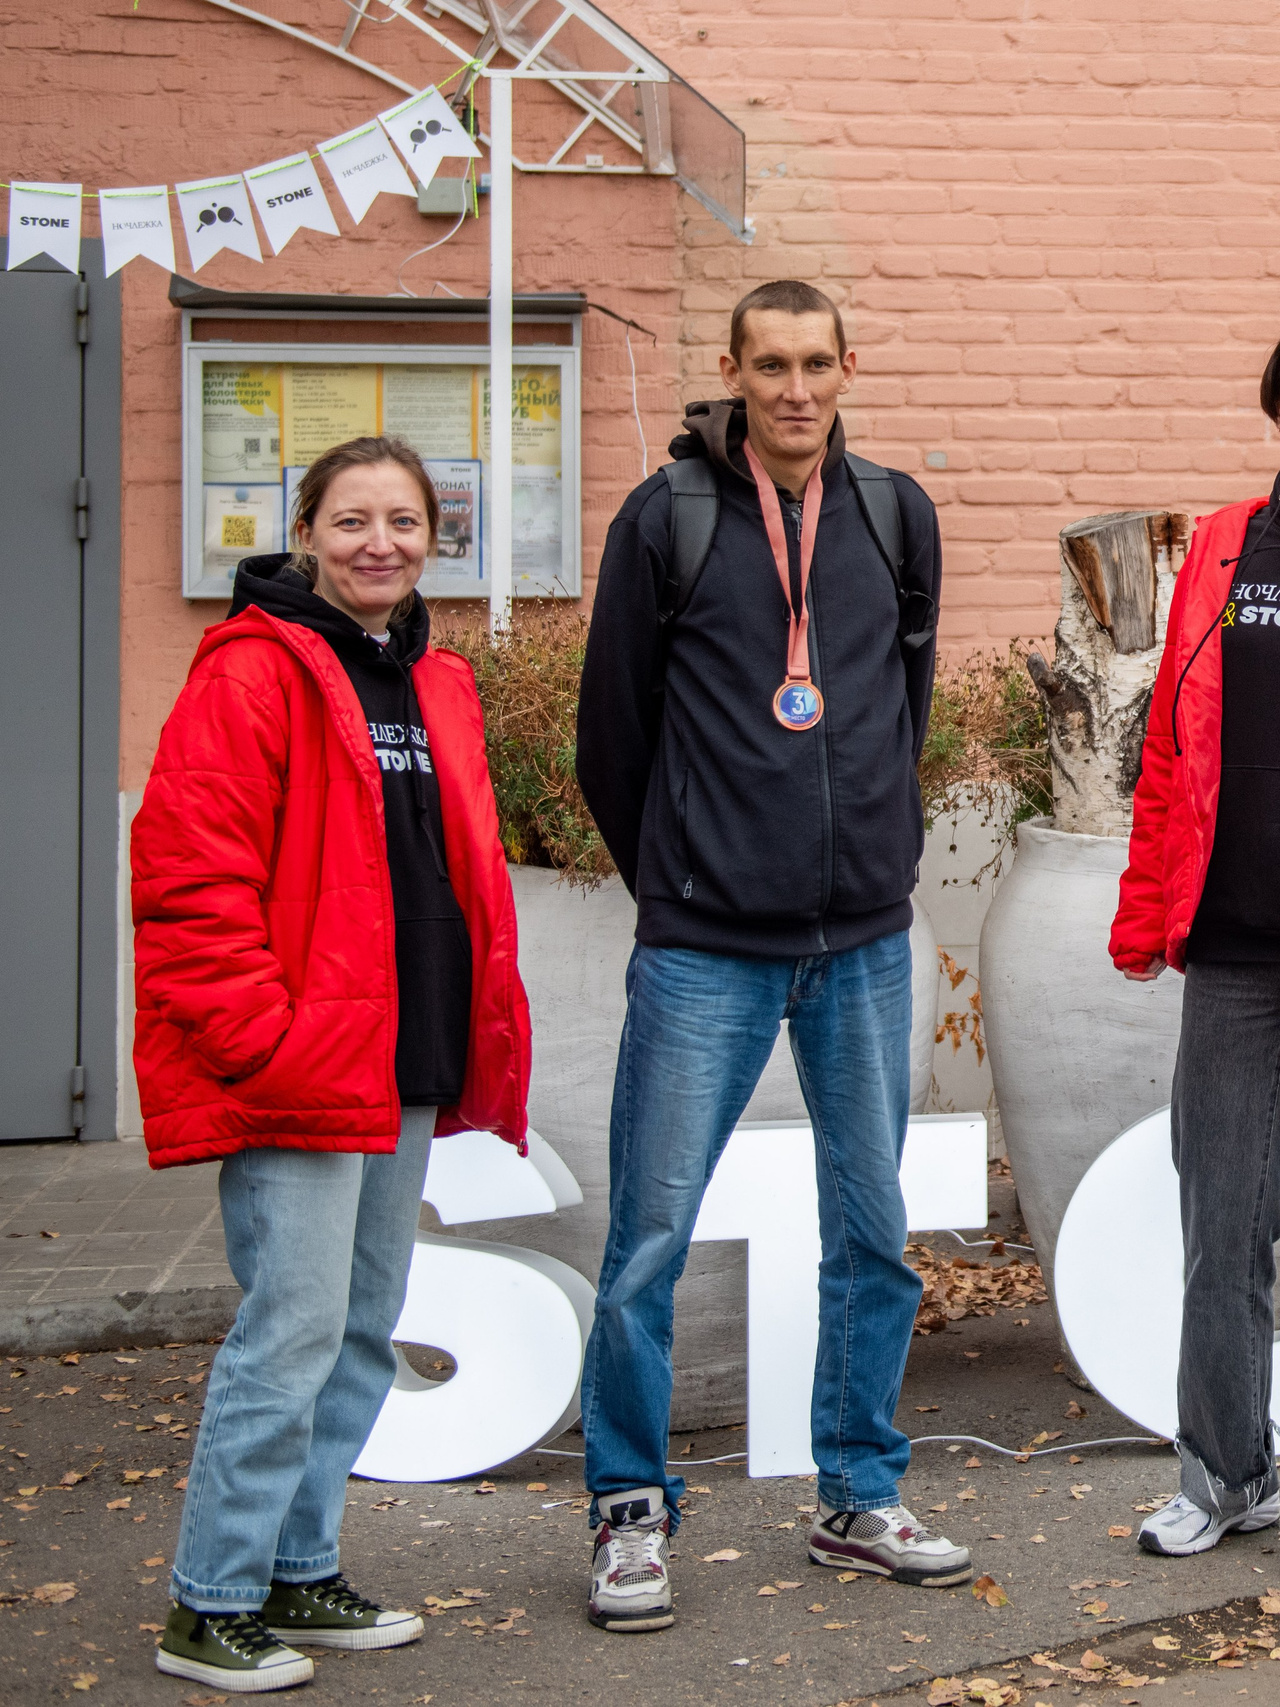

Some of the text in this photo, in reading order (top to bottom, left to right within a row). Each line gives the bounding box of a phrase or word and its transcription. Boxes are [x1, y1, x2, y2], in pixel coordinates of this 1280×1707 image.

[266, 186, 314, 209] STONE
[20, 216, 70, 228] STONE
[112, 220, 163, 230] НОЧЛЕЖКА
[483, 379, 546, 392] РЗГО-
[203, 390, 271, 398] волонтеров
[483, 390, 560, 406] ВРНЫЙ
[203, 398, 264, 406] Ночлежки
[483, 406, 530, 418] КУБ
[433, 481, 472, 491] ИОНАТ
[440, 503, 472, 514] ОНГУ
[1221, 602, 1235, 627] &
[792, 692, 804, 715] 3
[366, 723, 430, 748] ЧЛЕЖКА
[374, 749, 432, 774] TONE
